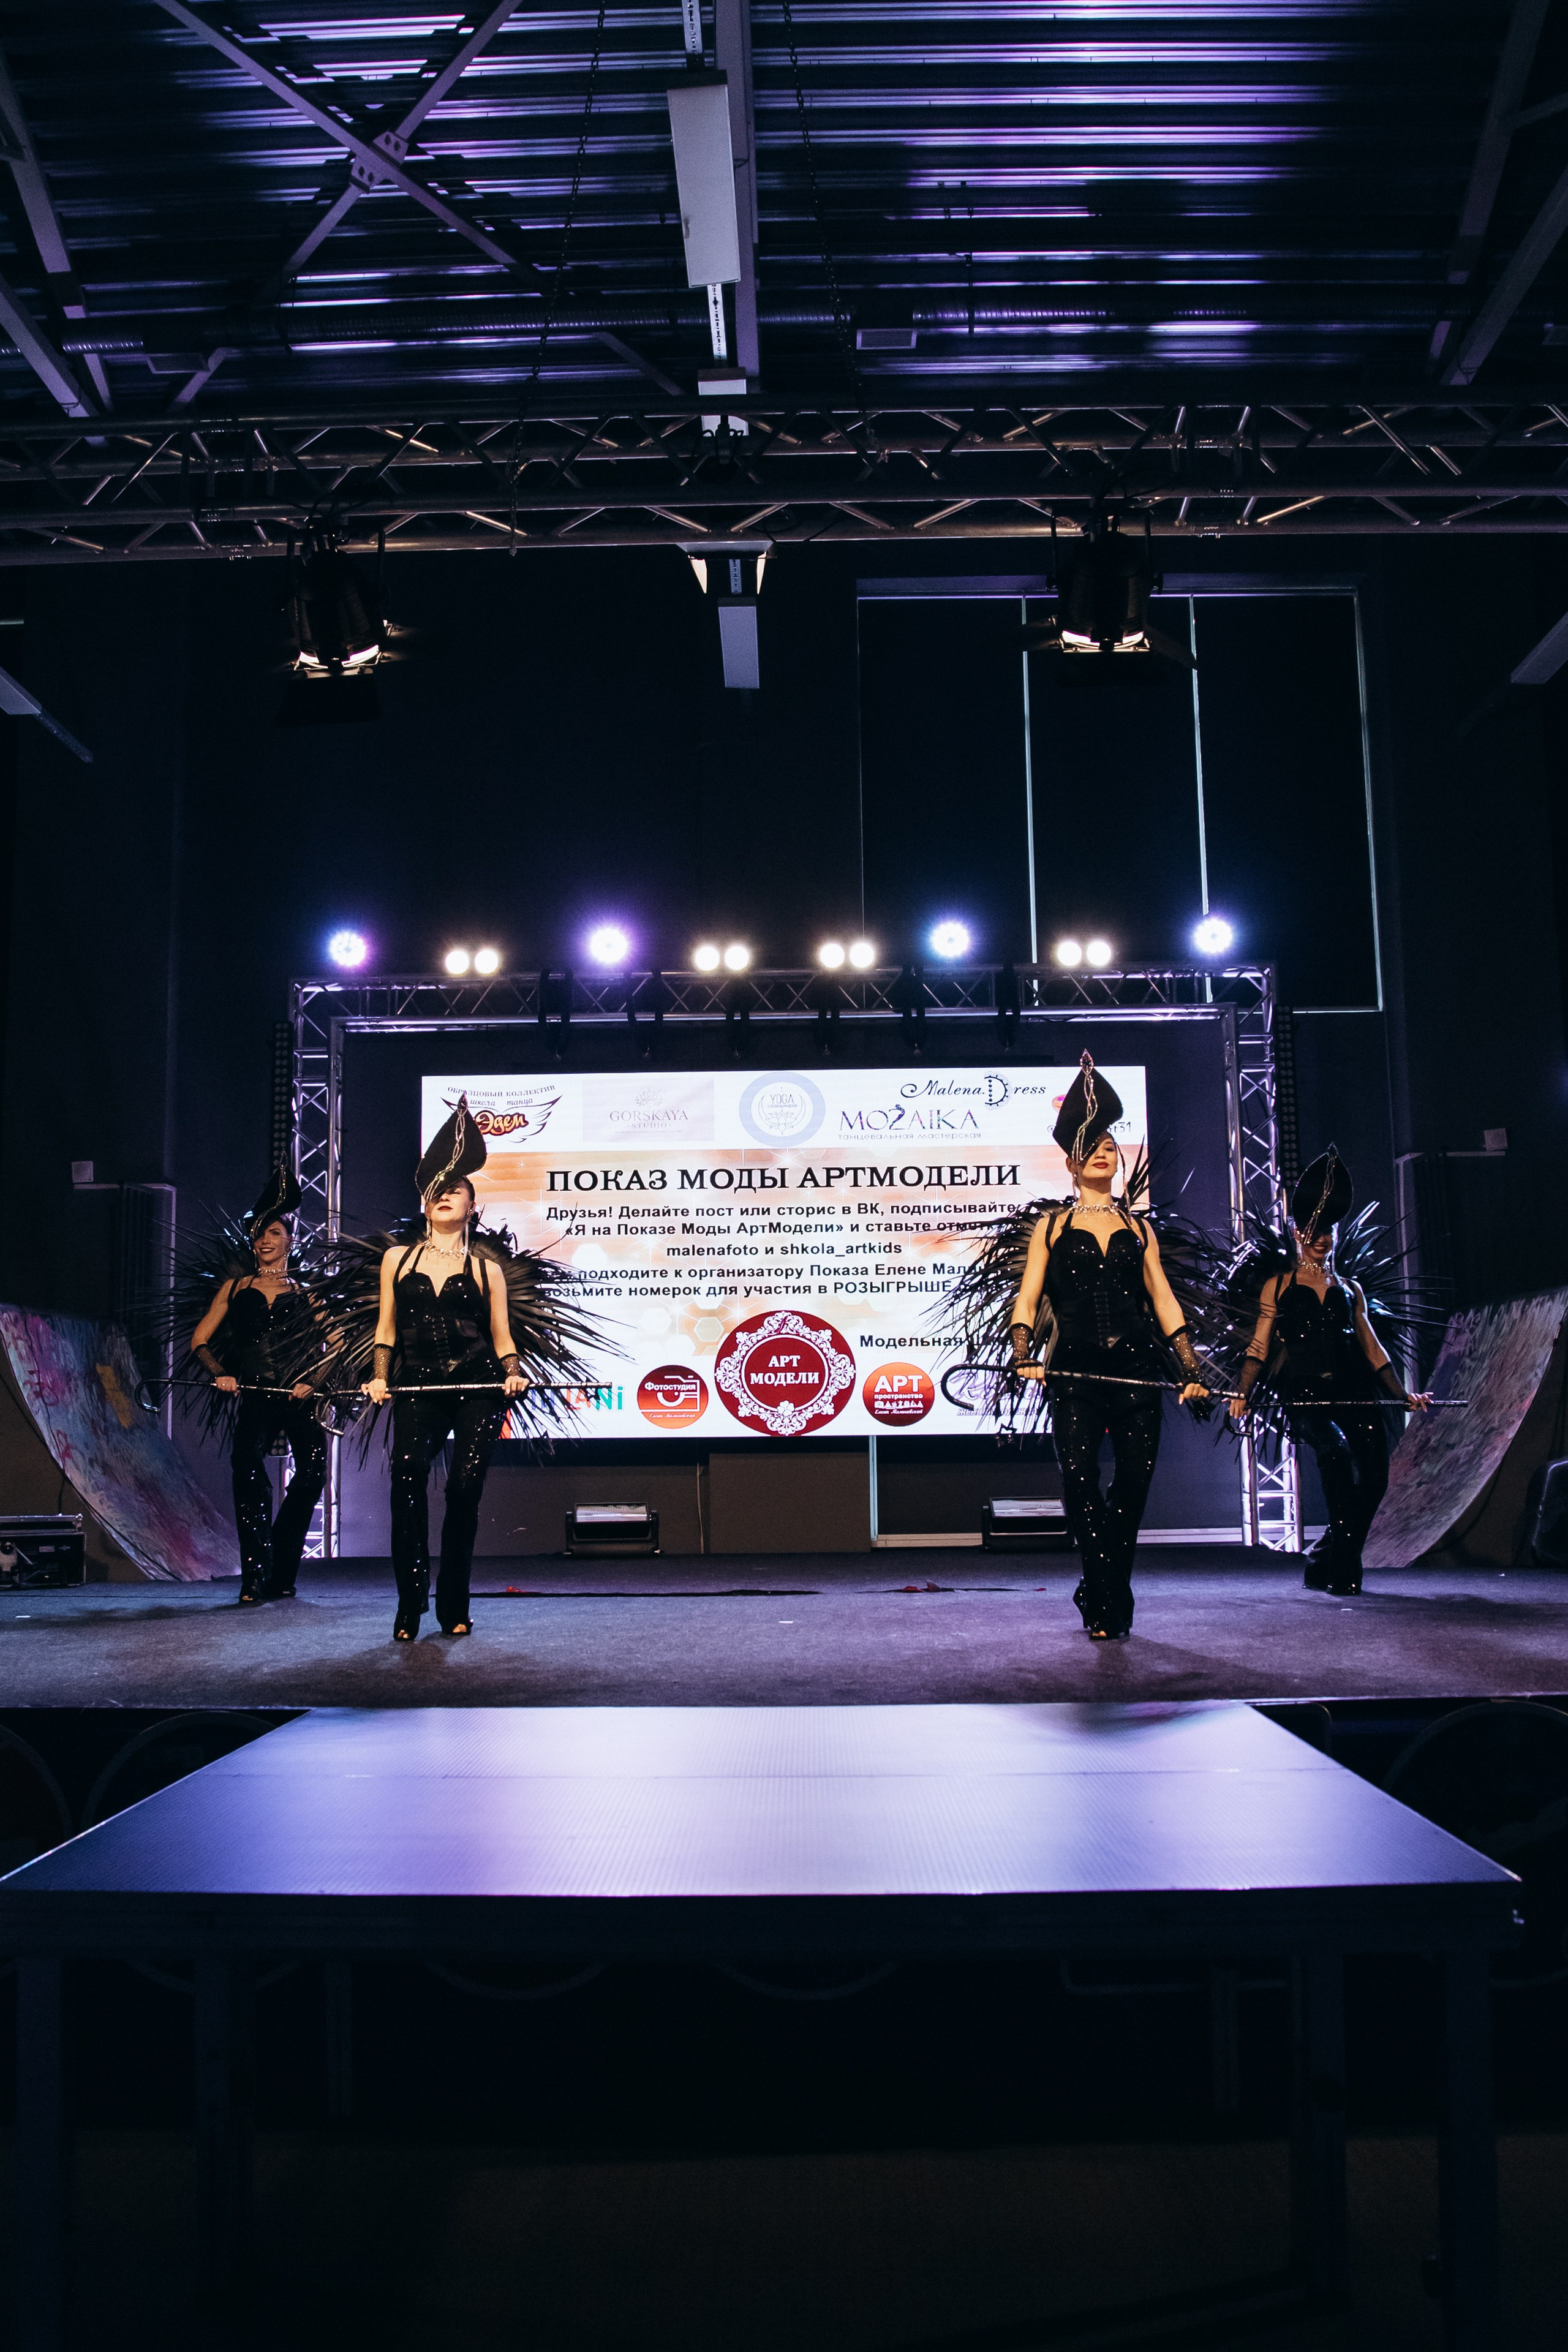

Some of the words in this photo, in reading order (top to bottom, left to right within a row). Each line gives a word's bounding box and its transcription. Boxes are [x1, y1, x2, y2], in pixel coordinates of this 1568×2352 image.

[506, 1085, 556, 1097] КОЛЛЕКТИВ
[770, 1093, 794, 1104] YOGA
[507, 1098, 533, 1107] танца
[475, 1110, 528, 1136] Эдем
[609, 1110, 688, 1121] GORSKAYA
[546, 1169, 668, 1191] ПОКАЗ
[677, 1167, 789, 1194] МОДЫ
[796, 1164, 1021, 1192] АРТМОДЕЛИ
[546, 1206, 612, 1221] Друзья!
[619, 1205, 690, 1219] Делайте
[696, 1208, 734, 1217] пост
[740, 1207, 771, 1216] или
[777, 1205, 836, 1218] сторис
[842, 1205, 851, 1215] в
[858, 1202, 884, 1216] ВК,
[891, 1201, 1017, 1215] подписывайте
[592, 1226, 611, 1235] на
[617, 1224, 676, 1235] Показе
[682, 1222, 730, 1235] Моды
[737, 1221, 843, 1236] АртМодели»
[851, 1223, 859, 1232] и
[866, 1222, 931, 1232] ставьте
[667, 1243, 758, 1256] malenafoto
[780, 1242, 902, 1257] shkola_artkids
[578, 1268, 668, 1281] подходите
[674, 1268, 682, 1278] к
[688, 1268, 804, 1281] организатору
[810, 1264, 869, 1276] Показа
[875, 1263, 926, 1275] Елене
[545, 1287, 622, 1297] возьмите
[628, 1286, 701, 1298] номерок
[706, 1286, 737, 1297] для
[744, 1284, 812, 1298] участия
[818, 1284, 827, 1294] в
[834, 1281, 952, 1293] РОЗЫГРЫШЕ
[860, 1335, 963, 1349] Модельная
[768, 1355, 801, 1368] АРТ
[644, 1381, 696, 1391] Фотостудия
[750, 1372, 820, 1387] МОДЕЛИ
[874, 1375, 923, 1393] АРТ
